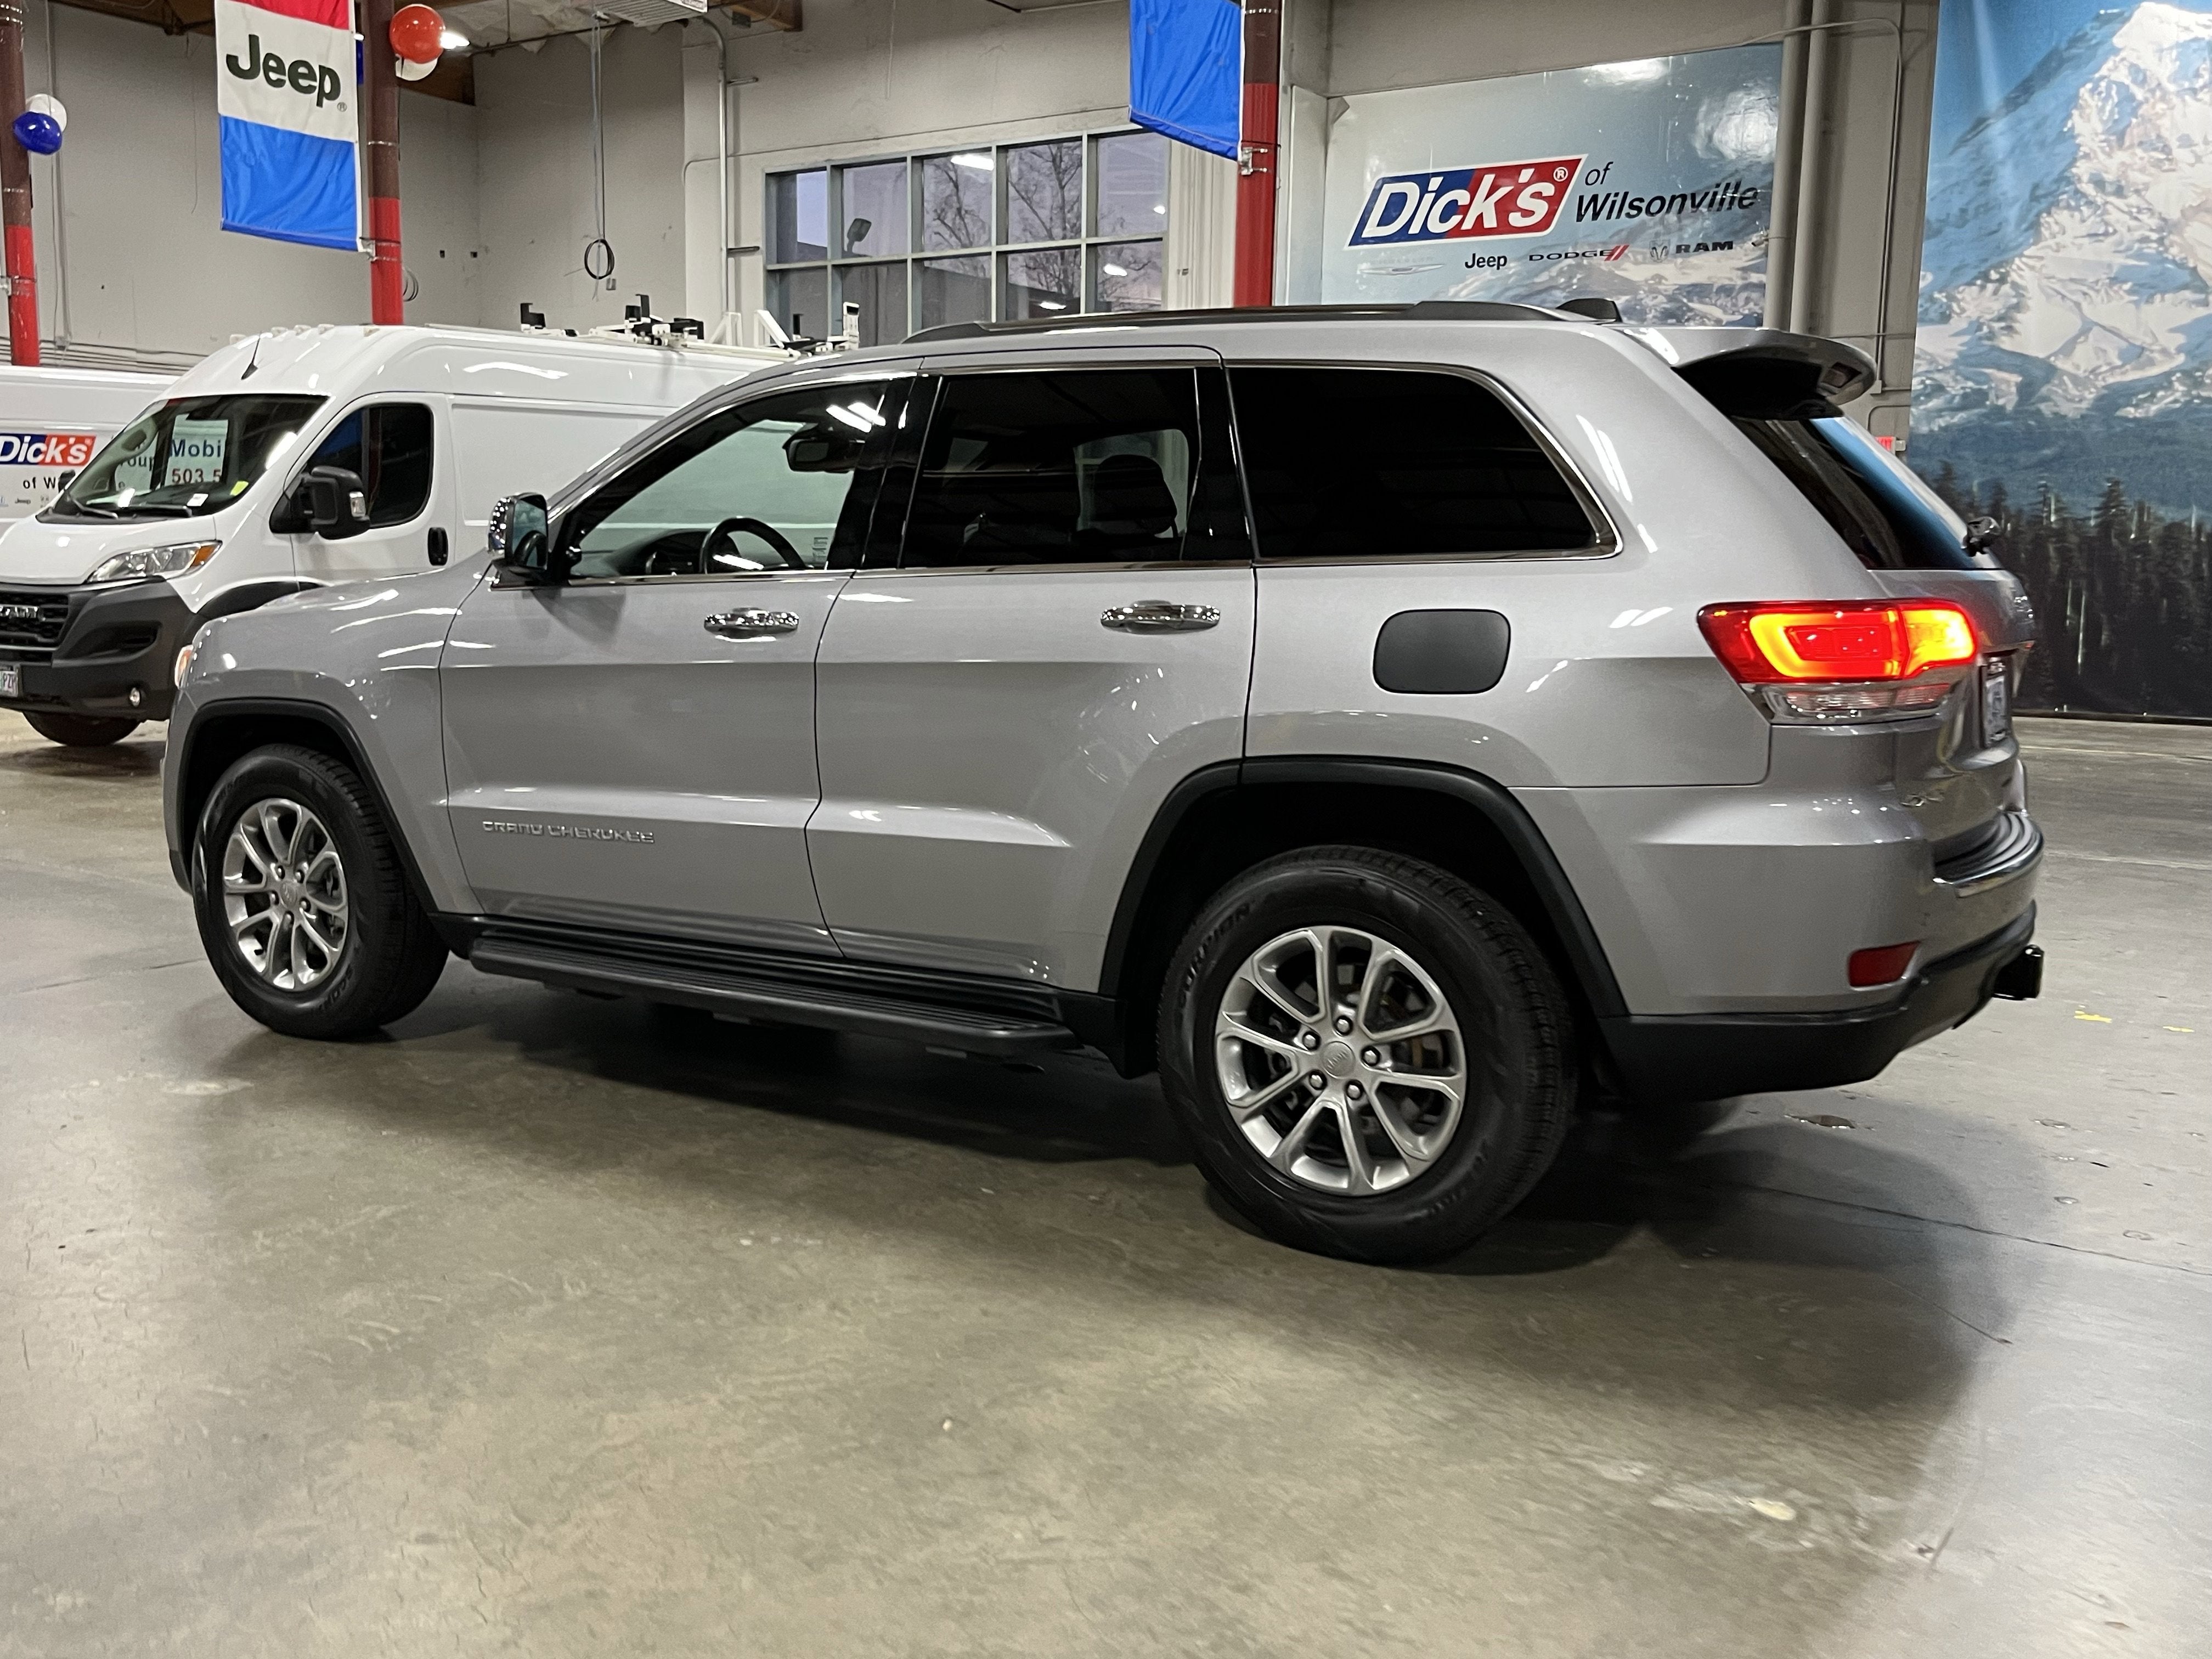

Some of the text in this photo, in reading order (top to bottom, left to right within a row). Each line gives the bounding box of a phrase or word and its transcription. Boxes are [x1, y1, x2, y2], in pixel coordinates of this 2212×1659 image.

[226, 34, 341, 108] Jeep
[1585, 162, 1613, 185] of
[1361, 168, 1555, 238] Dick's
[1576, 179, 1758, 222] Wilsonville
[1465, 241, 1733, 269] Jeep DODGE RAM
[0, 436, 88, 464] Dick's
[170, 439, 221, 457] Mobi
[23, 477, 36, 489] of
[172, 469, 204, 484] 503
